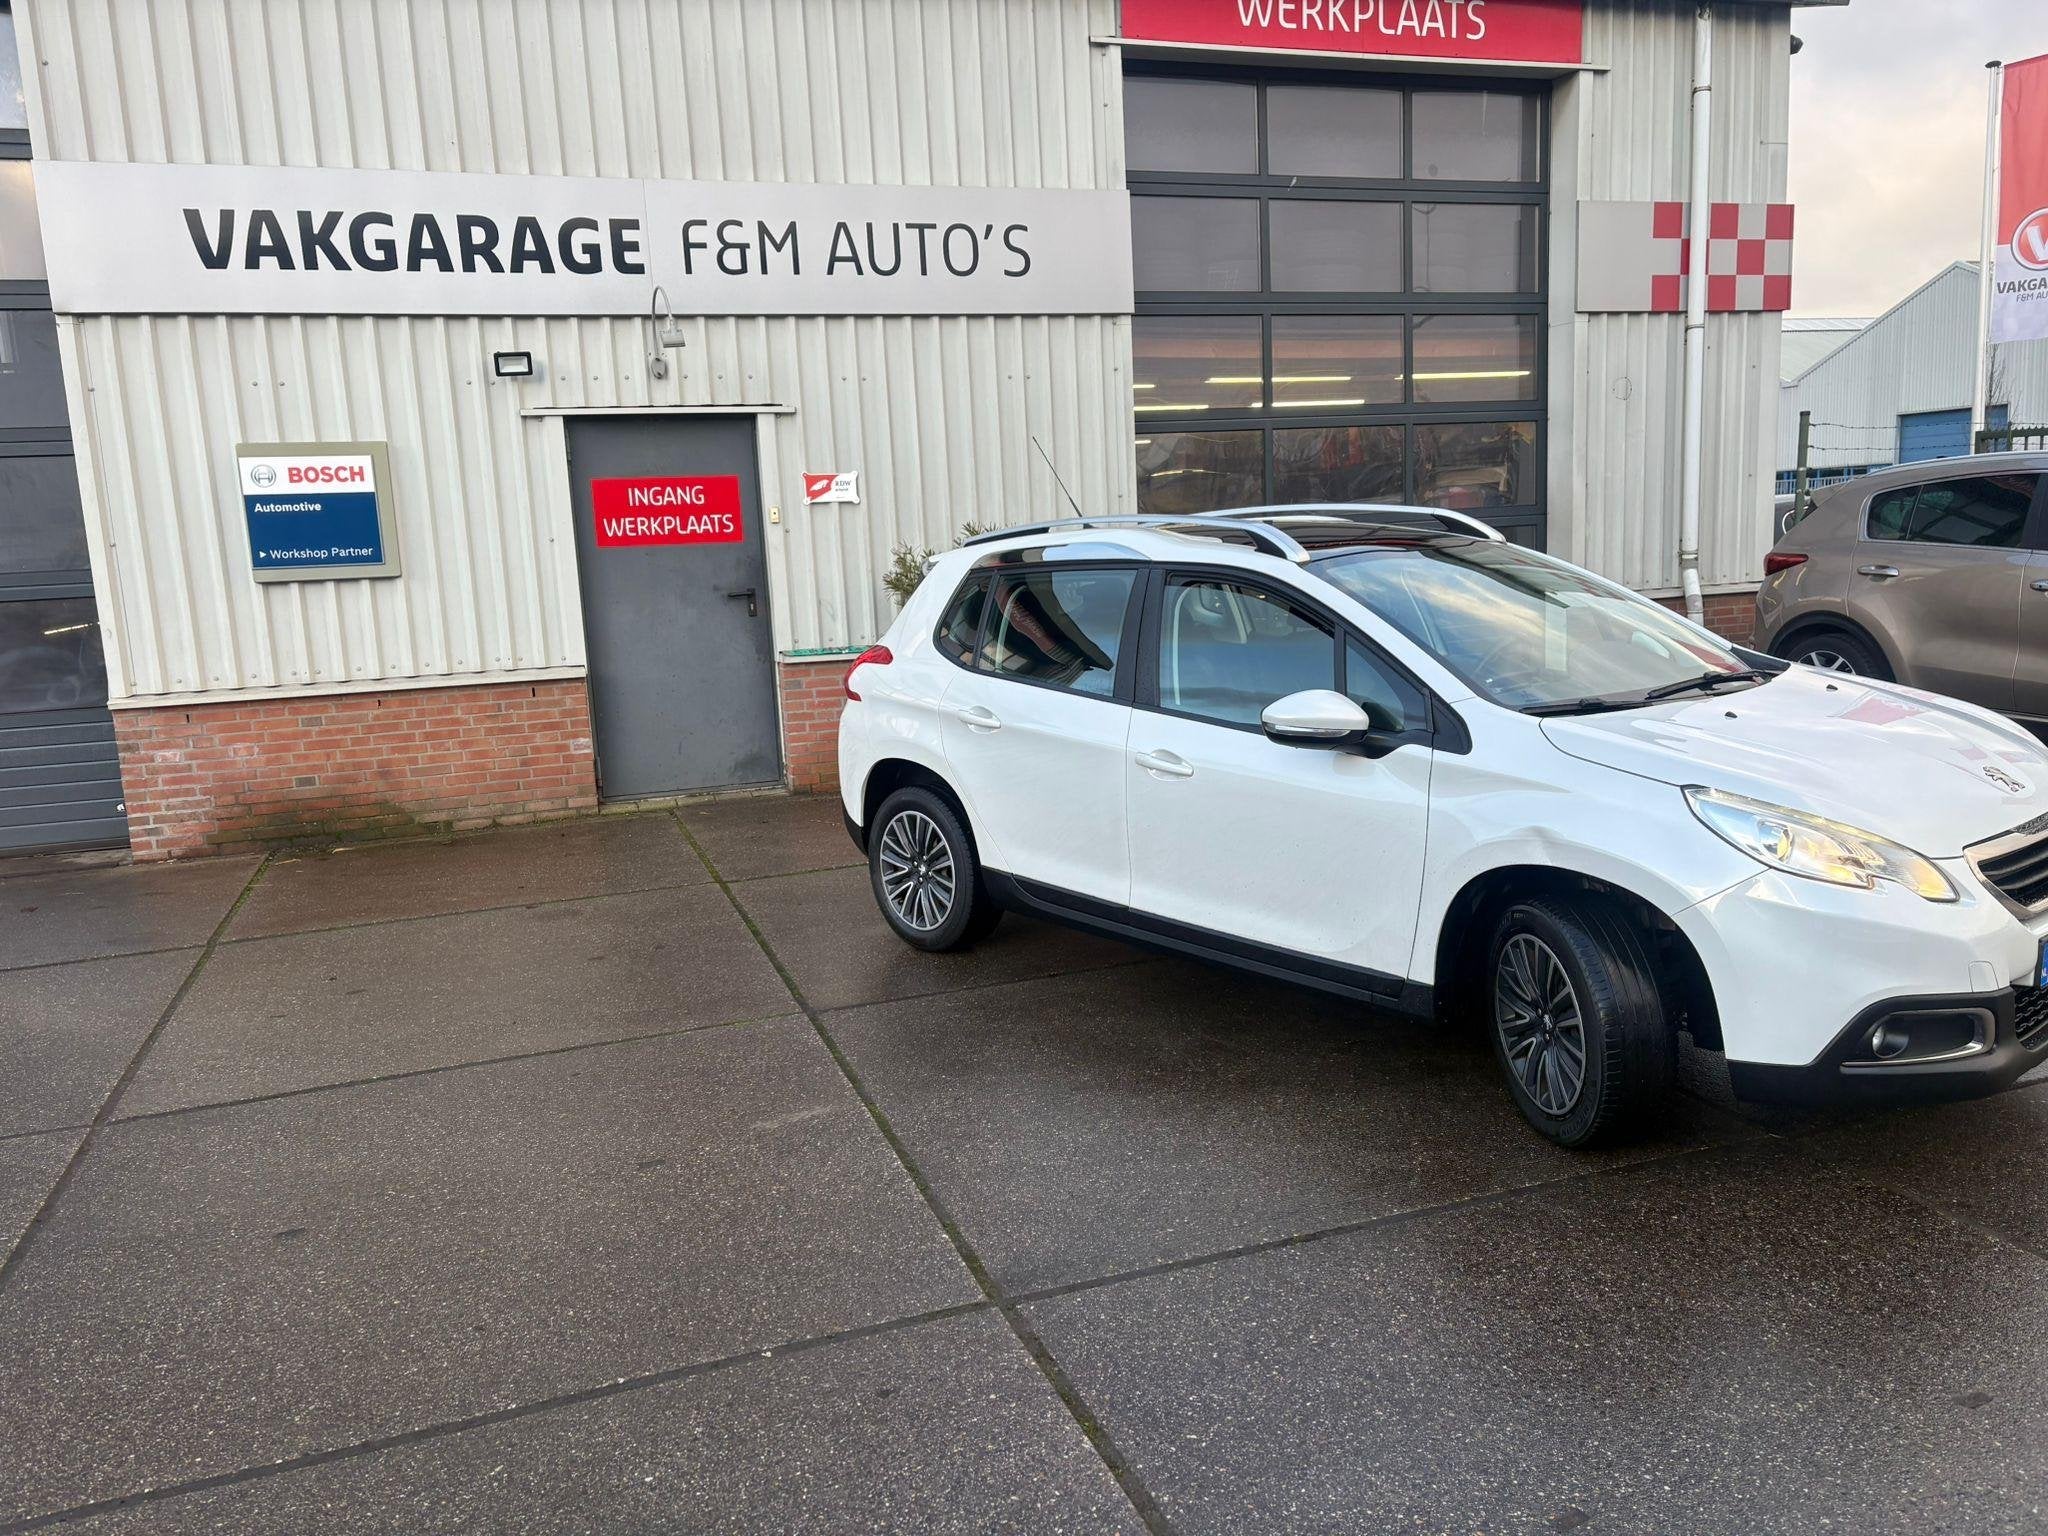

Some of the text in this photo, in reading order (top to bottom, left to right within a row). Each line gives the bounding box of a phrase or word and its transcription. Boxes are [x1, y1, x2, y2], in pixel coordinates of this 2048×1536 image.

[1237, 0, 1486, 40] WERKPLAATS
[183, 207, 1033, 277] VAKGARAGE F&M AUTO'S
[1997, 277, 2048, 294] VAKGA
[2036, 290, 2048, 300] AU
[289, 466, 365, 483] BOSCH
[628, 486, 705, 507] INGANG
[254, 502, 322, 513] Automotive
[603, 514, 734, 538] WERKPLAATS
[270, 547, 373, 559] Workshop Partner
